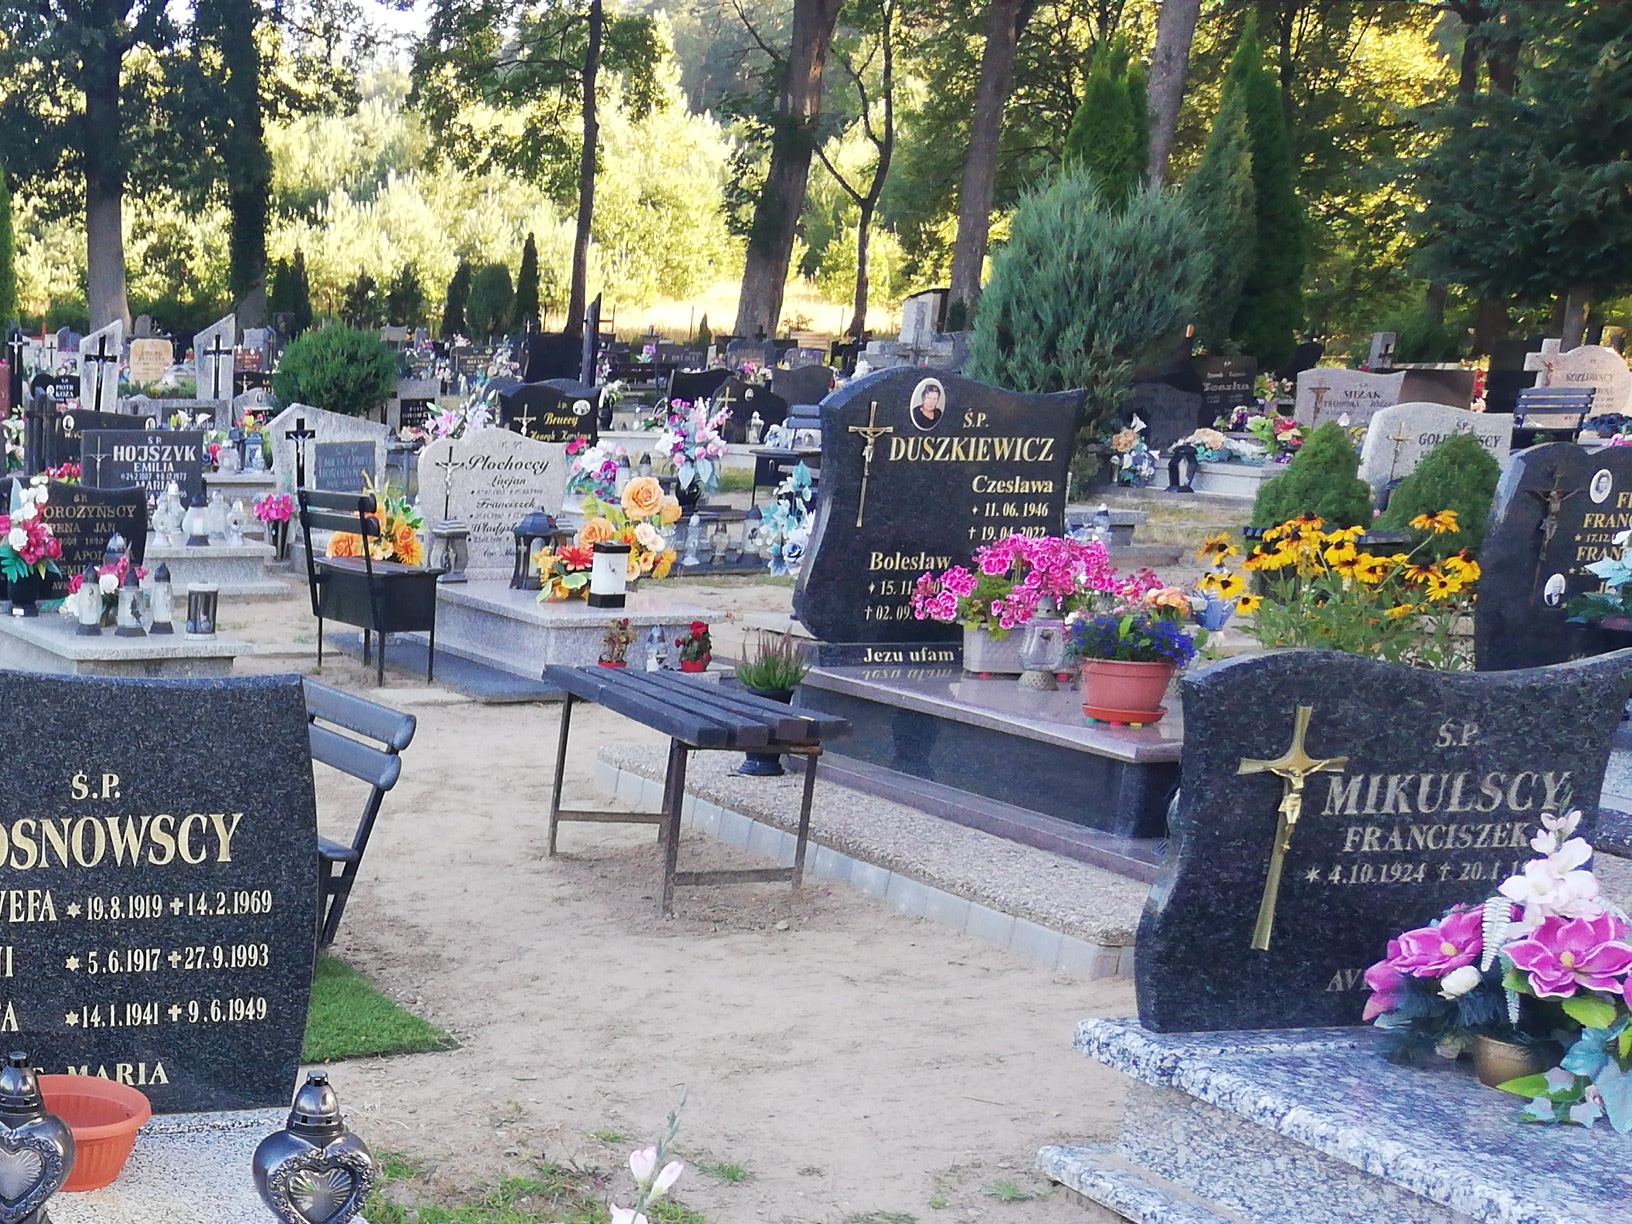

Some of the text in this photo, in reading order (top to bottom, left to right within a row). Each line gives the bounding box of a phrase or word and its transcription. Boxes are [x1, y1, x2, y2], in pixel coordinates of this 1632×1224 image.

[963, 408, 989, 429] Ś.P.
[113, 445, 197, 462] HOJSZYK
[889, 437, 1055, 462] DUSZKIEWICZ
[133, 462, 175, 472] EMILIA
[972, 474, 1054, 494] Czesława
[475, 498, 536, 509] Franciszek
[48, 523, 116, 533] RENA JAN
[869, 551, 953, 571] Bolesław
[863, 647, 955, 662] Jezu ufam
[71, 770, 121, 799] Ś.P.
[1322, 770, 1574, 816] MIKULSCY
[1343, 822, 1531, 853] FRANCISZEK
[1328, 863, 1426, 884] 4.10.1924
[87, 893, 163, 920] 19.8.1919
[187, 889, 272, 916] 14.2.1969
[87, 947, 161, 975] 5.6.1917
[184, 944, 269, 970] 27.9.1993
[82, 1003, 159, 1029] 14.1.1941
[188, 998, 267, 1023] 9.6.1949
